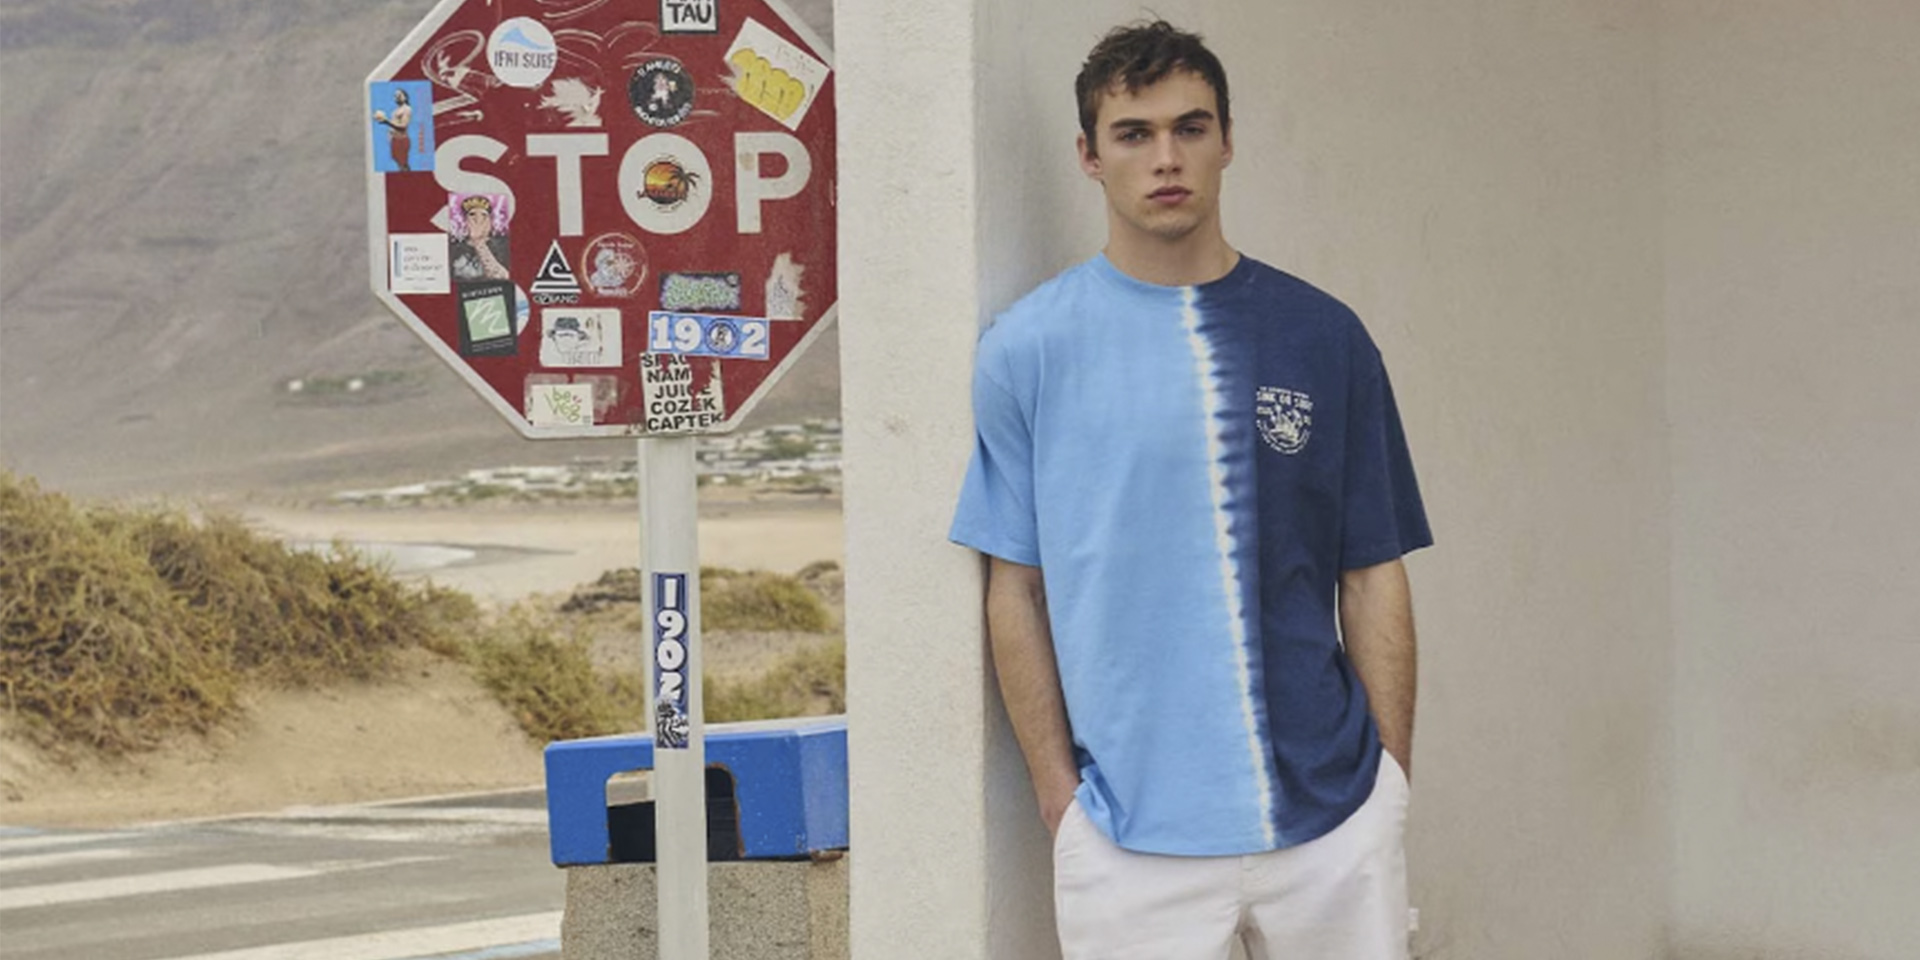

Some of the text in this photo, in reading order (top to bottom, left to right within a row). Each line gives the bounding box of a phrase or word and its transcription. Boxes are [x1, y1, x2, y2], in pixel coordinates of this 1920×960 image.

[666, 3, 712, 24] TAU
[430, 130, 813, 237] STOP
[650, 398, 717, 415] COZEK
[647, 413, 722, 431] CAPTEK
[656, 577, 686, 700] 1902
